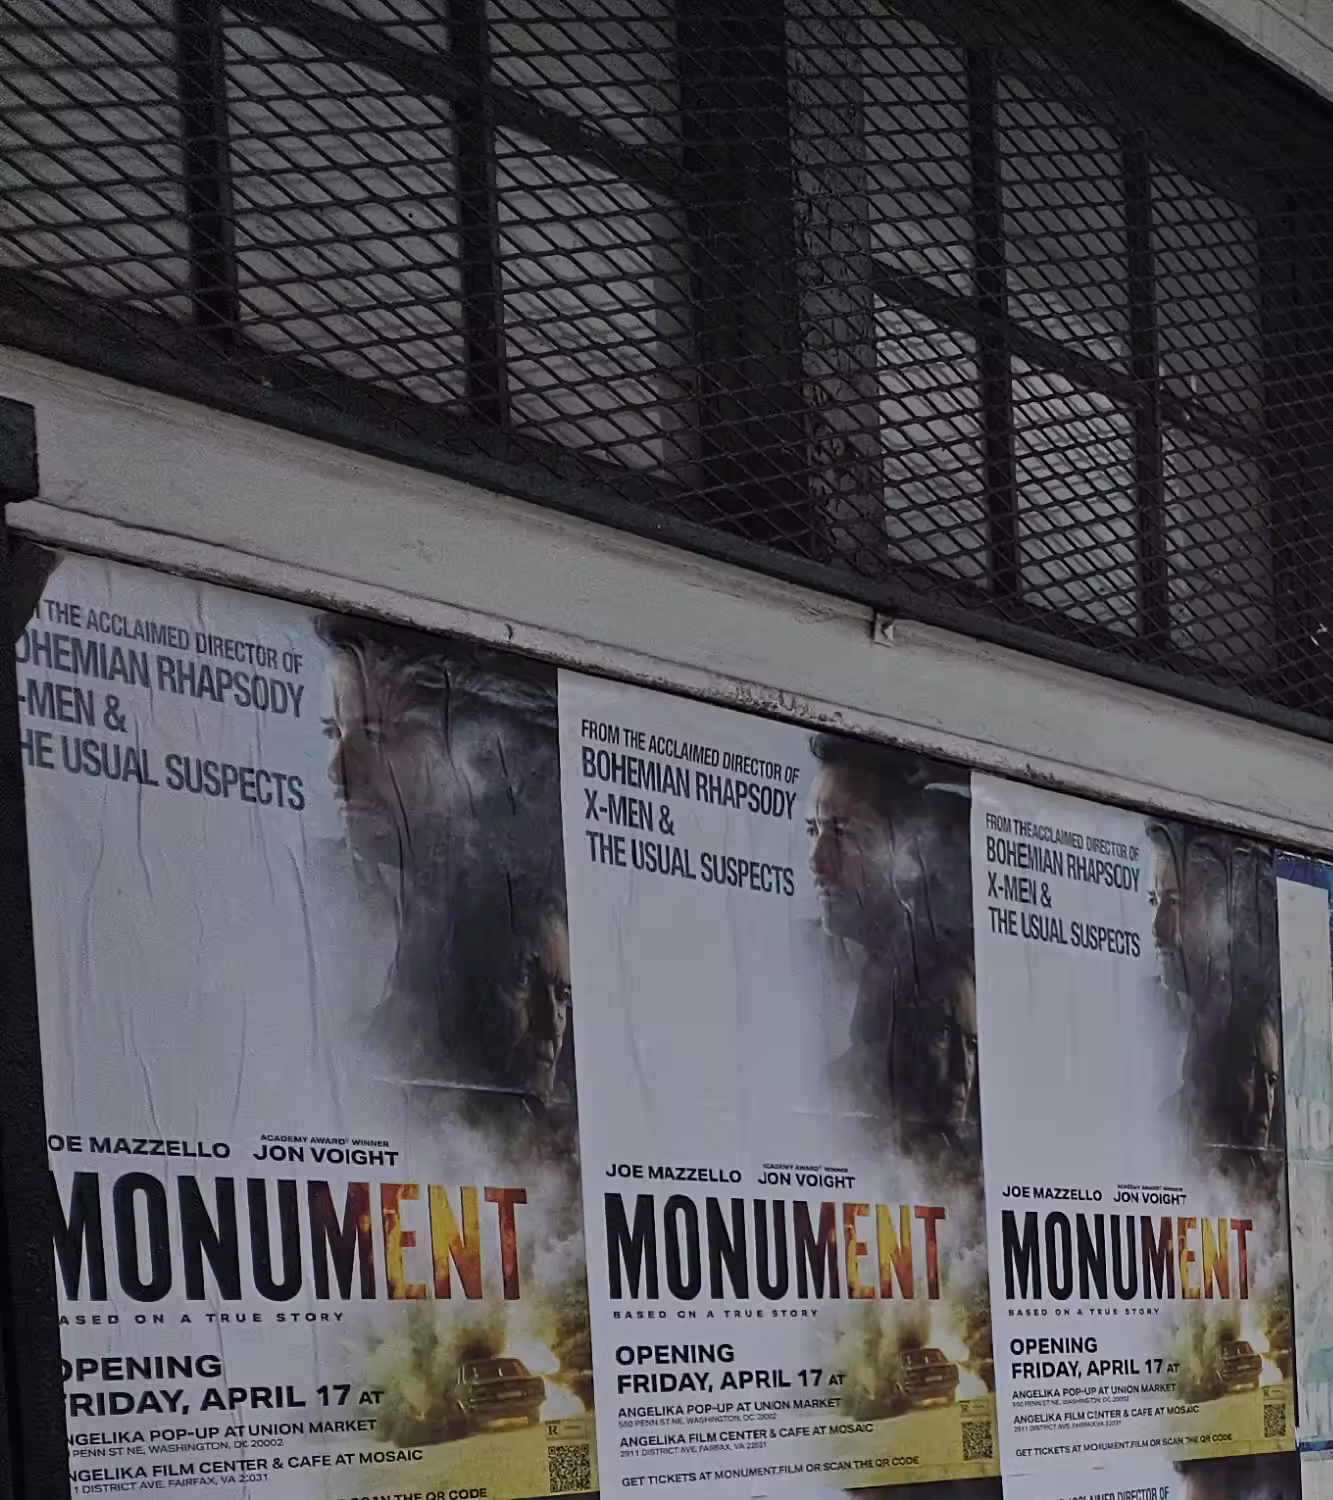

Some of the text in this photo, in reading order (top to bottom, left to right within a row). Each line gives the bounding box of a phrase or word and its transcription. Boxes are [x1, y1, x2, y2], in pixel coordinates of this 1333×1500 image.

[44, 599, 303, 674] THE ACCLAIMED DIRECTOR OF
[16, 628, 305, 718] OHEMIAN RHAPSODY
[18, 678, 128, 733] -MEN &
[21, 729, 306, 811] HE USUAL SUSPECTS
[581, 719, 799, 784] FROM THE ACCLAIMED DIRECTOR OF
[581, 746, 796, 820] BOHEMIAN RHAPSODY
[584, 788, 675, 836] X-MEN &
[586, 830, 795, 896] THE USUAL SUSPECTS
[987, 836, 1140, 893] BOHEMIAN RHAPSODY
[987, 870, 1052, 909] X-MEN &
[988, 906, 1141, 957] THE USUAL SUSPECTS
[47, 1133, 231, 1160] OE MAZZELLO
[252, 1144, 399, 1167] JON VOIGHT
[605, 1163, 742, 1184] JOE MAZZELLO
[757, 1171, 855, 1190] JON VOIGHT
[48, 1170, 527, 1303] MONUMENT
[604, 1192, 945, 1301] MONUMENT
[1001, 1209, 1253, 1300] MONUMENT
[615, 1343, 735, 1366] OPENING
[1010, 1336, 1098, 1355] OPENING
[1012, 1358, 1180, 1379] FRIDAY, APRIL 17 AT
[64, 1384, 385, 1417] RIDAY, APRIL 17 AT
[617, 1369, 846, 1395] FRIDAY, APRIL 17 AT
